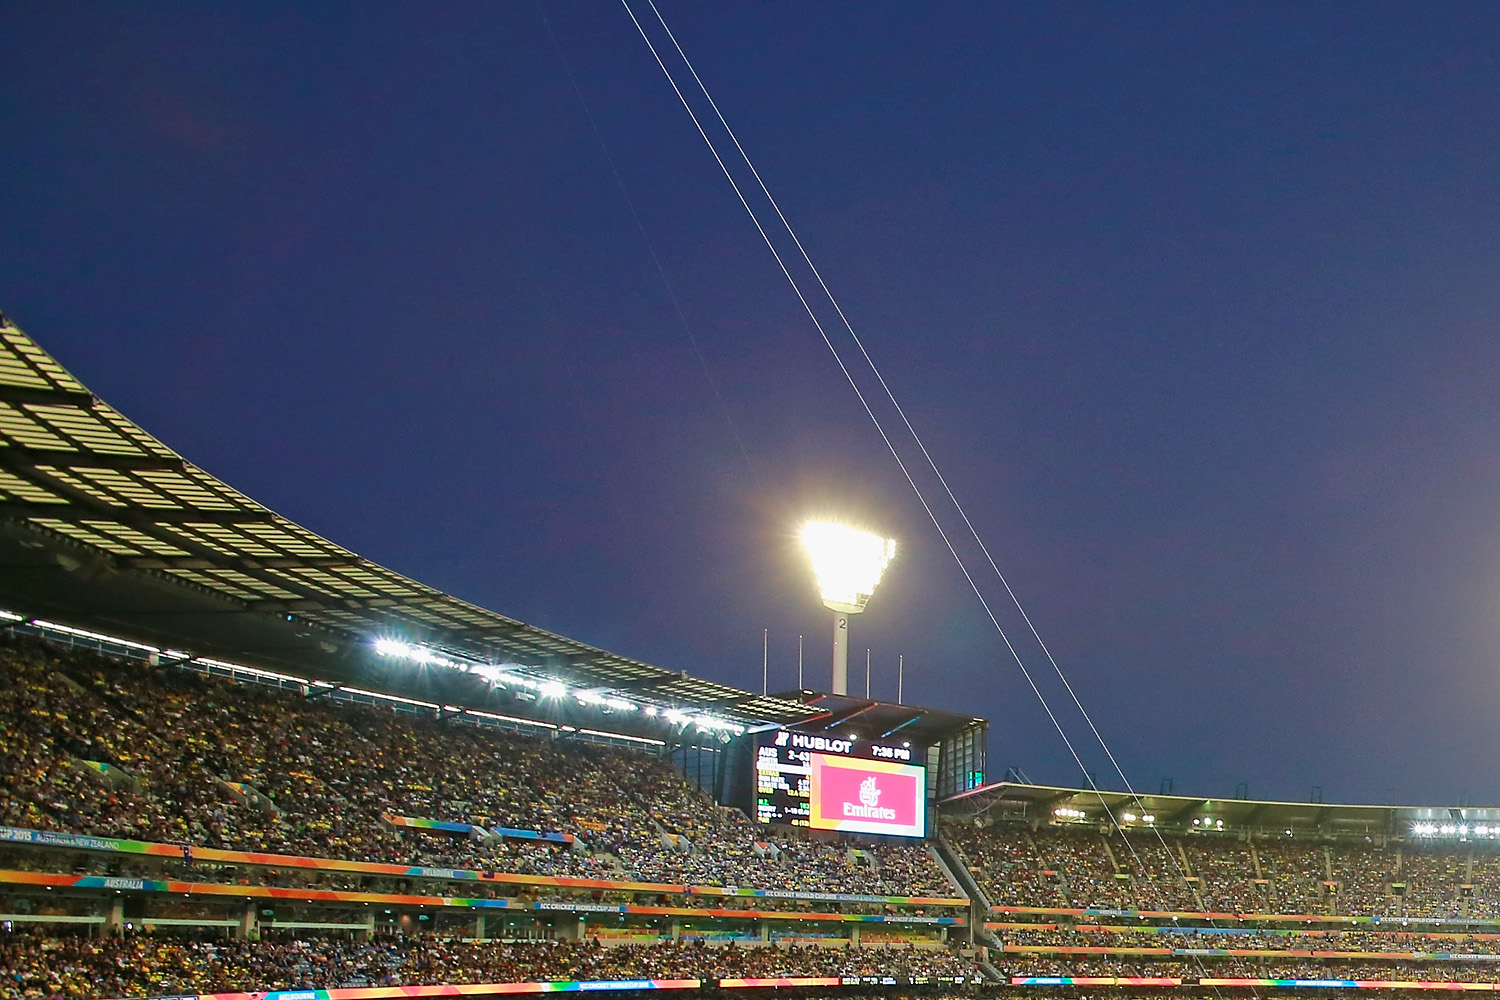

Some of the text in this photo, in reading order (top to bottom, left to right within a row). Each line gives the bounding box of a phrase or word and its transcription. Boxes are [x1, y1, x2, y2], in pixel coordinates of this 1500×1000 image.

[793, 734, 852, 753] HUBLOT
[759, 747, 777, 757] AUS
[894, 749, 910, 760] PM
[843, 802, 895, 819] Emirates
[14, 831, 31, 840] 2015
[37, 834, 70, 844] AUSTRALIA
[90, 840, 119, 849] ZEALAND
[104, 879, 143, 889] AUSTRALIA
